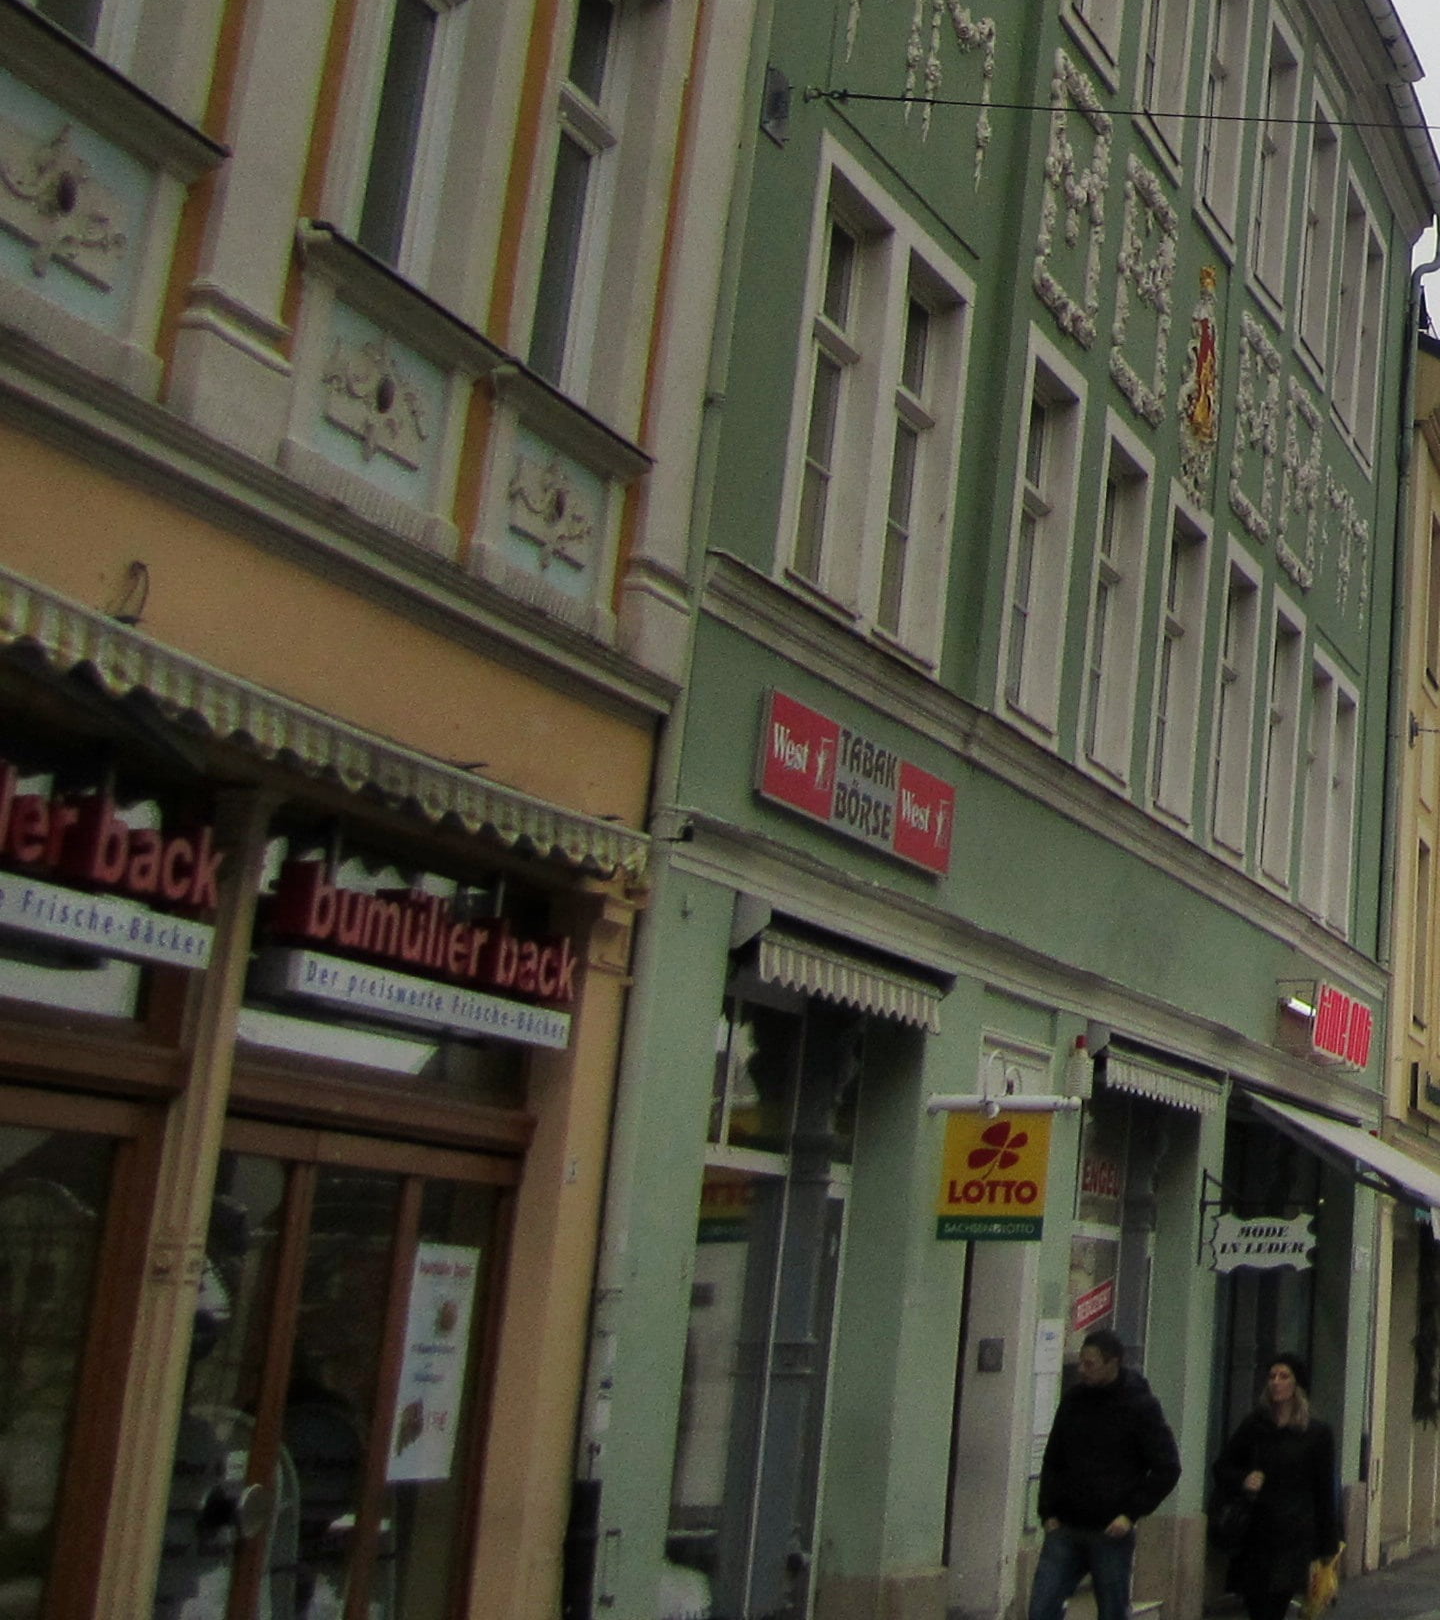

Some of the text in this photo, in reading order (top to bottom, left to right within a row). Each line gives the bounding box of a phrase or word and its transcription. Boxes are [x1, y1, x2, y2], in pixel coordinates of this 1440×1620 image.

[773, 722, 810, 774] West
[840, 729, 900, 791] TABAK
[833, 779, 893, 842] BÖRSE
[902, 787, 931, 833] West
[94, 782, 225, 908] back
[21, 888, 207, 956] Frische-Bäcker
[306, 861, 578, 1002] bumüller back
[305, 959, 340, 986] Der
[349, 974, 445, 1013] preiswerte
[947, 1179, 1039, 1205] LOTTO
[1220, 1242, 1305, 1255] IN LEDER
[1237, 1225, 1290, 1238] MODE
